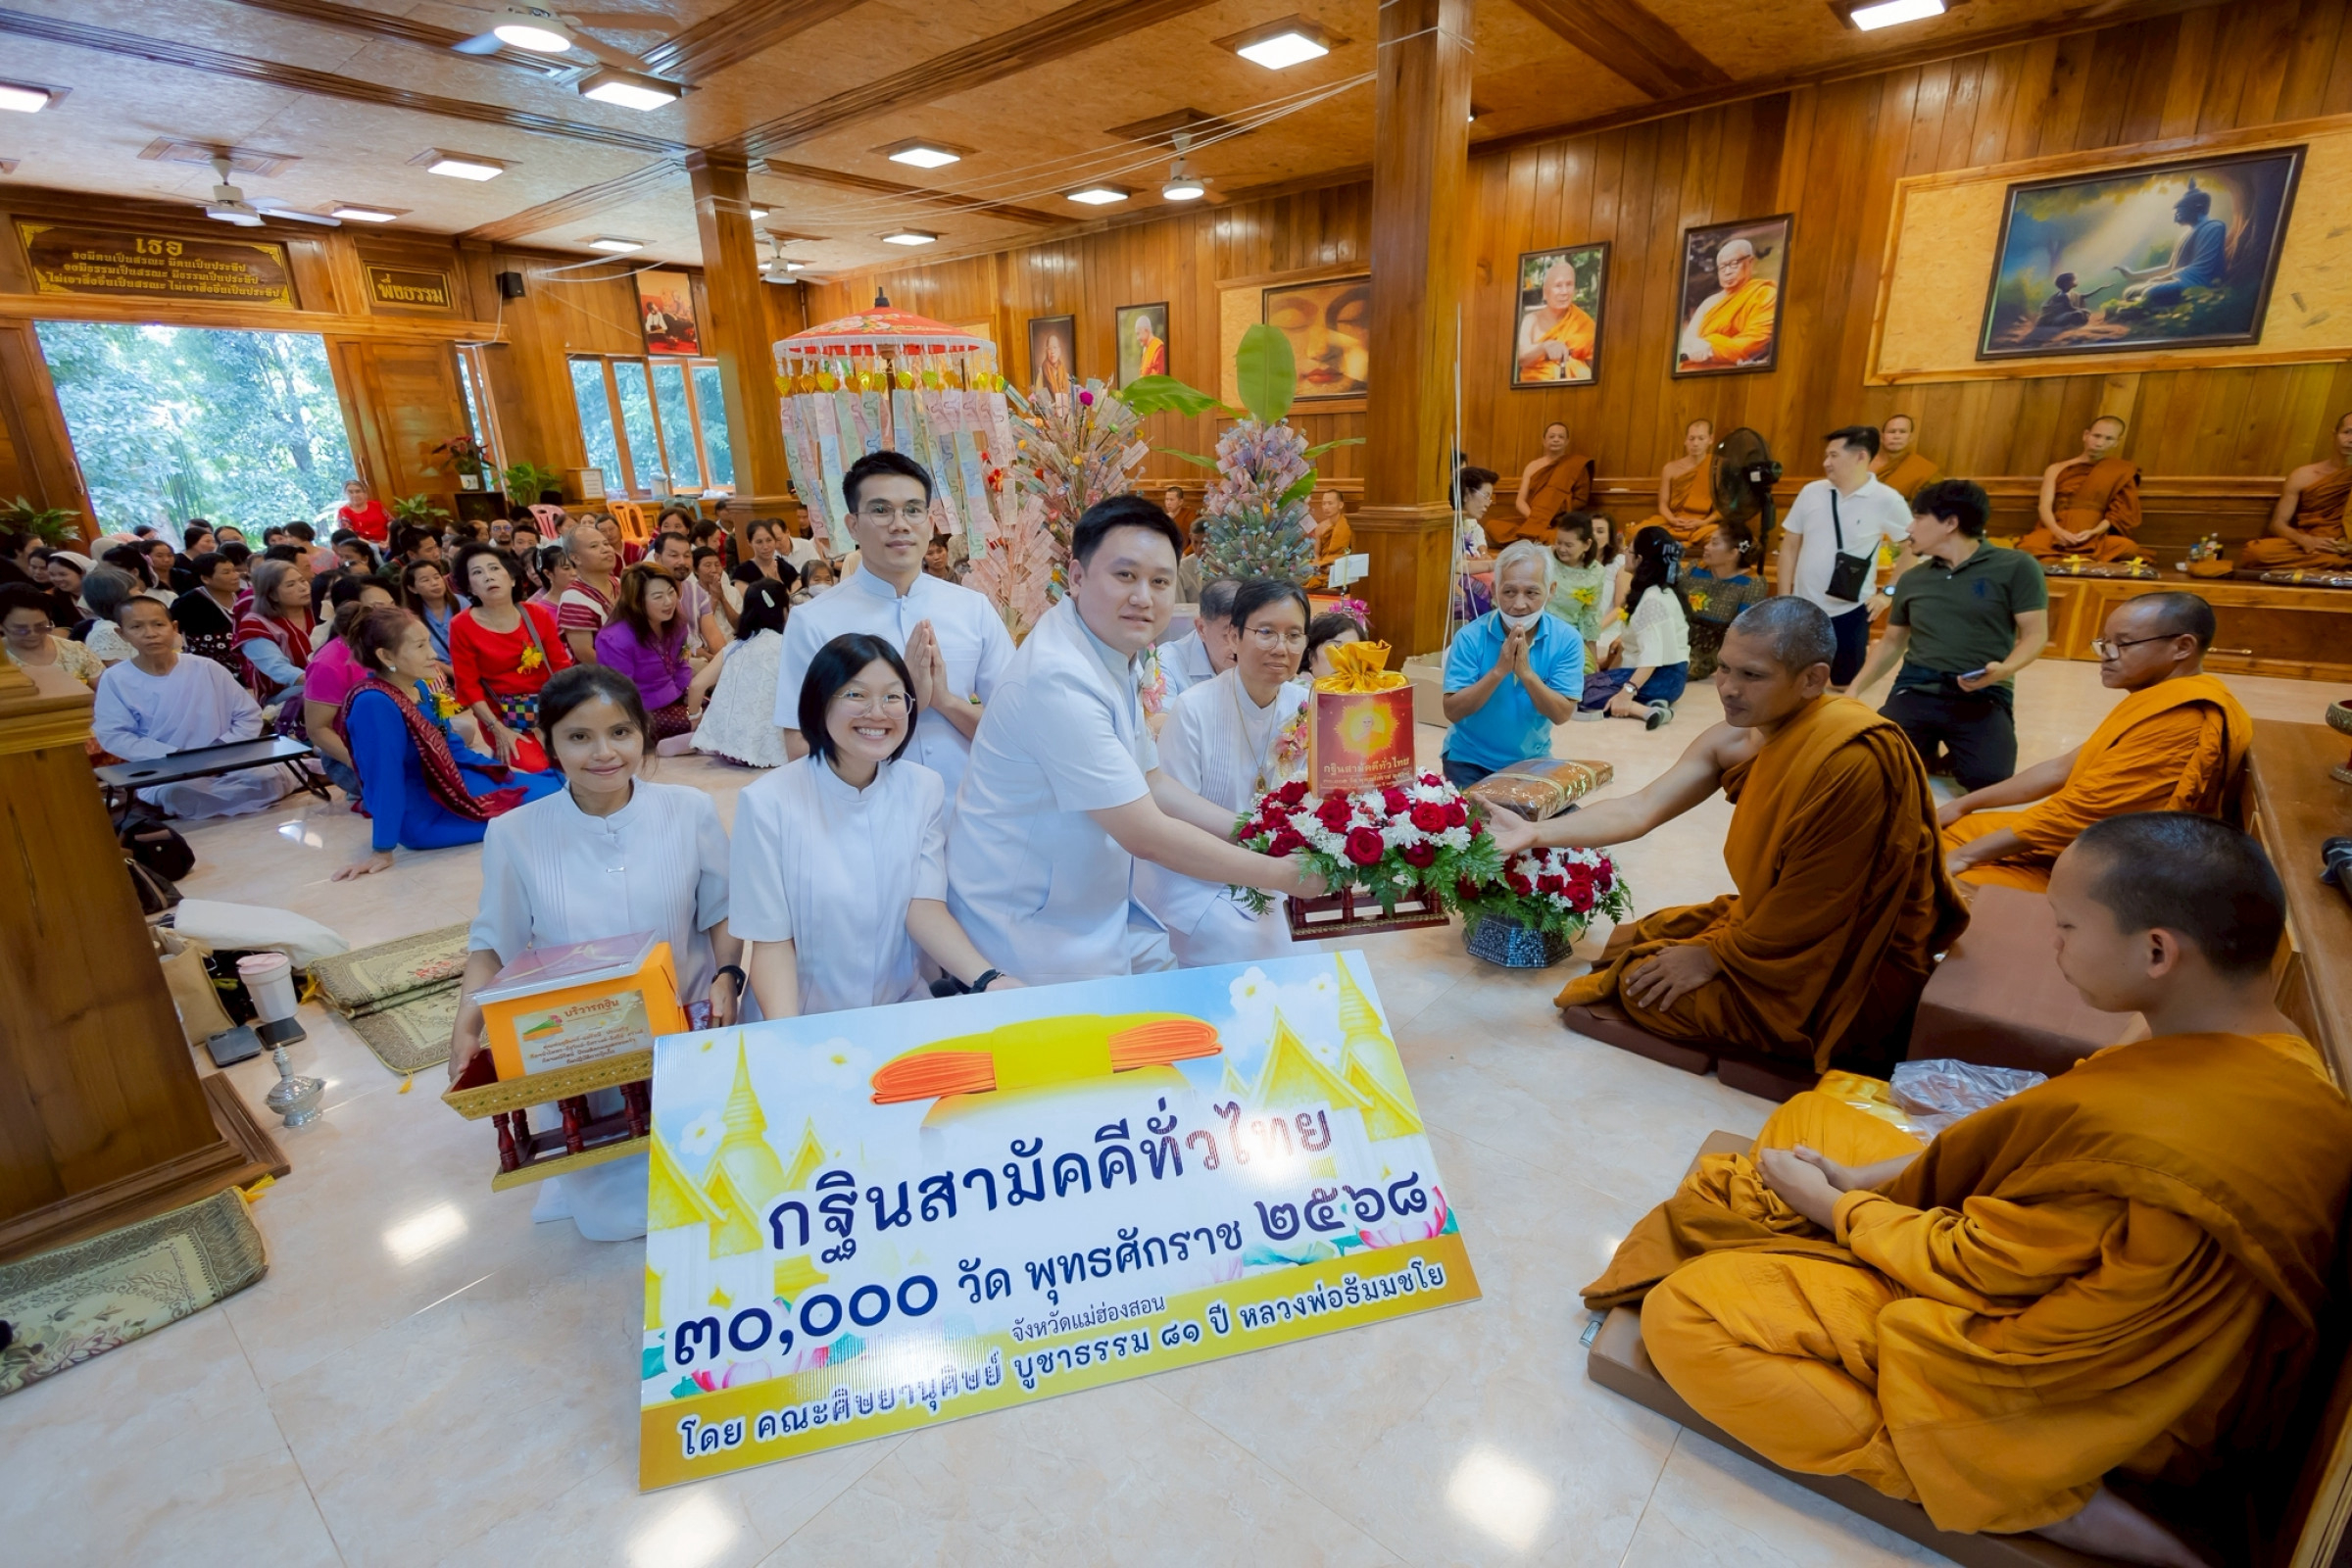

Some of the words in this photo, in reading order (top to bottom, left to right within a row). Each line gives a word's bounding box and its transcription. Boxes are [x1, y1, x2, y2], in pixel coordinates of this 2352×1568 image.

[136, 238, 183, 257] เธอ
[564, 998, 620, 1018] บริวารกฐิน
[767, 1096, 1333, 1264] กฐินสามัคคีทั่วไทย
[673, 1274, 939, 1366] ๓๐,๐๐๐
[957, 1256, 1012, 1304] วัด
[1024, 1220, 1243, 1306] พุทธศักราช
[1253, 1170, 1428, 1242] ๒๕๖๘
[1011, 1296, 1166, 1343] จังหวัดแม่ฮ่องสอน
[681, 1419, 742, 1456] โดย
[1014, 1331, 1150, 1390] บูชาธรรม
[1161, 1323, 1200, 1347] ๘๑
[1208, 1302, 1230, 1335] ปี
[1239, 1260, 1445, 1328] หลวงพ่อธัมมชโย
